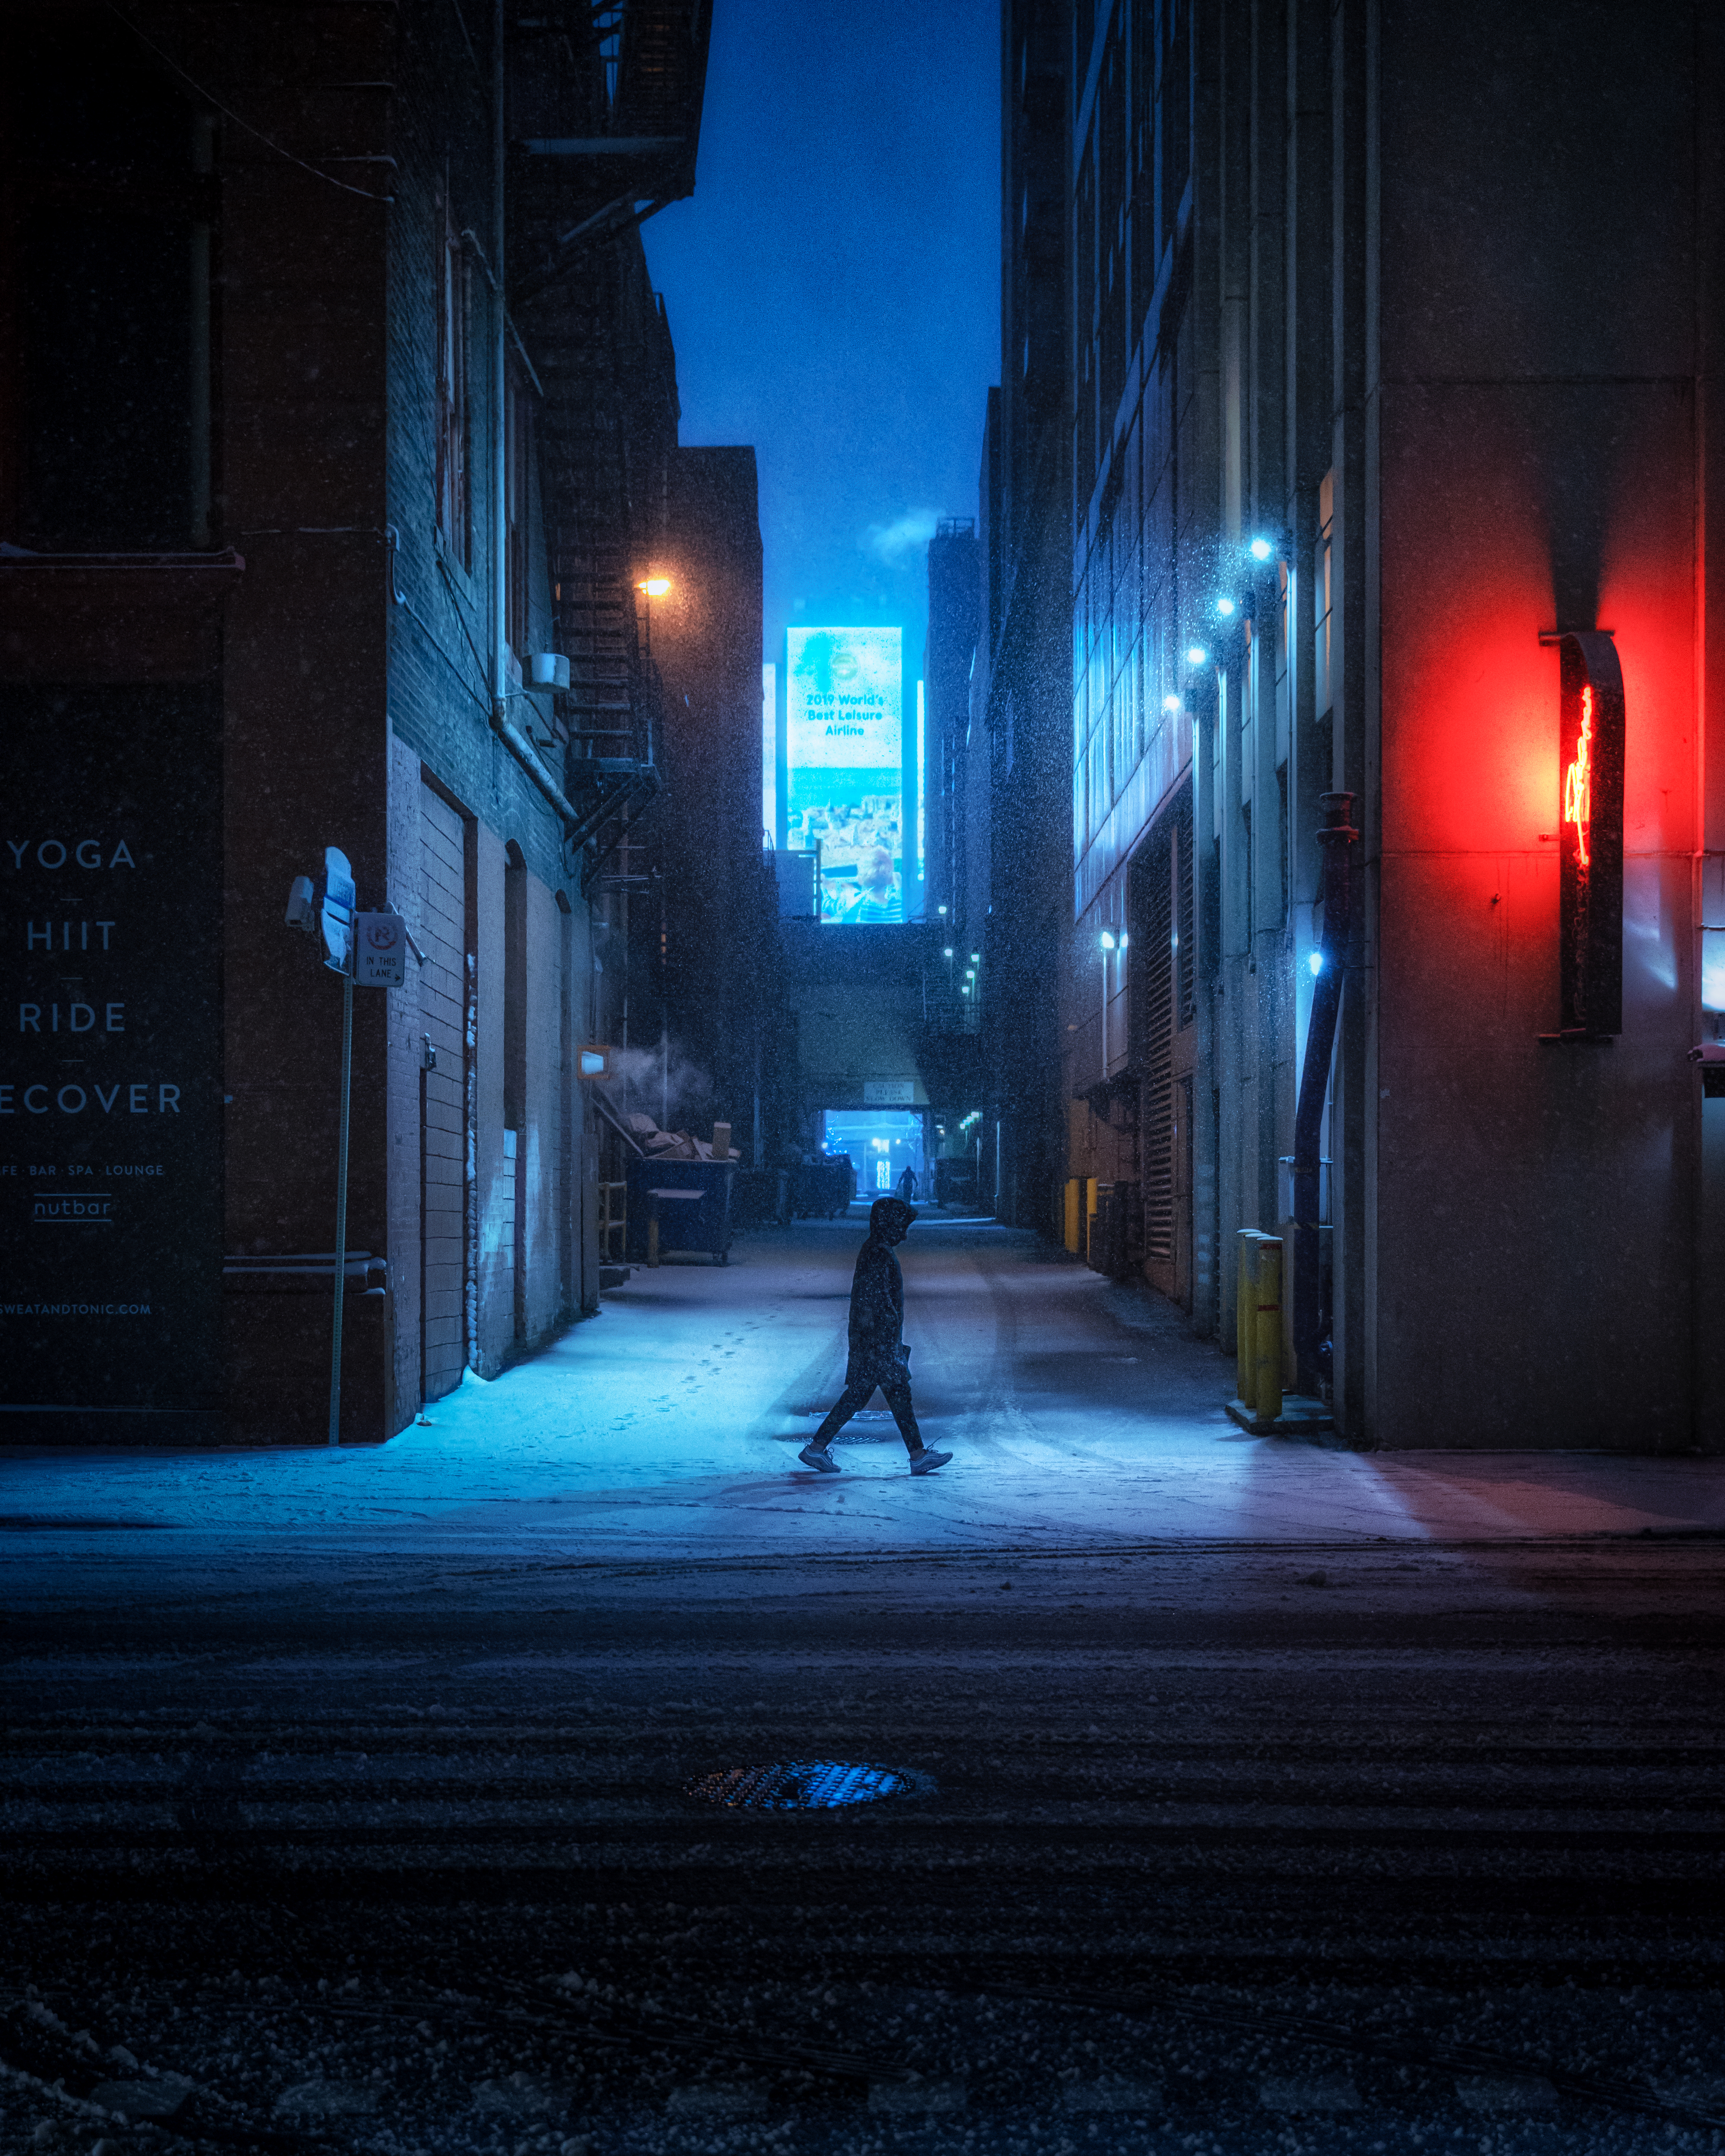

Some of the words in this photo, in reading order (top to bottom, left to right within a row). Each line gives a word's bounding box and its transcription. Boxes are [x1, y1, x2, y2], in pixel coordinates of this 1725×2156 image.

[806, 694, 834, 705] 2019
[839, 694, 884, 706] World's
[808, 710, 834, 721] Best
[838, 710, 882, 721] Leisure
[825, 725, 865, 736] Airline
[6, 840, 136, 869] YOGA
[28, 921, 116, 950] HIIT
[367, 956, 374, 965] IN
[380, 957, 396, 966] THIS
[370, 969, 392, 978] LANE
[20, 1003, 125, 1032] RIDE
[0, 1166, 17, 1175] FE
[30, 1166, 56, 1175] BAR
[68, 1166, 94, 1175] SPA
[106, 1166, 164, 1176] LOUNGE
[34, 1200, 110, 1215] nutbar
